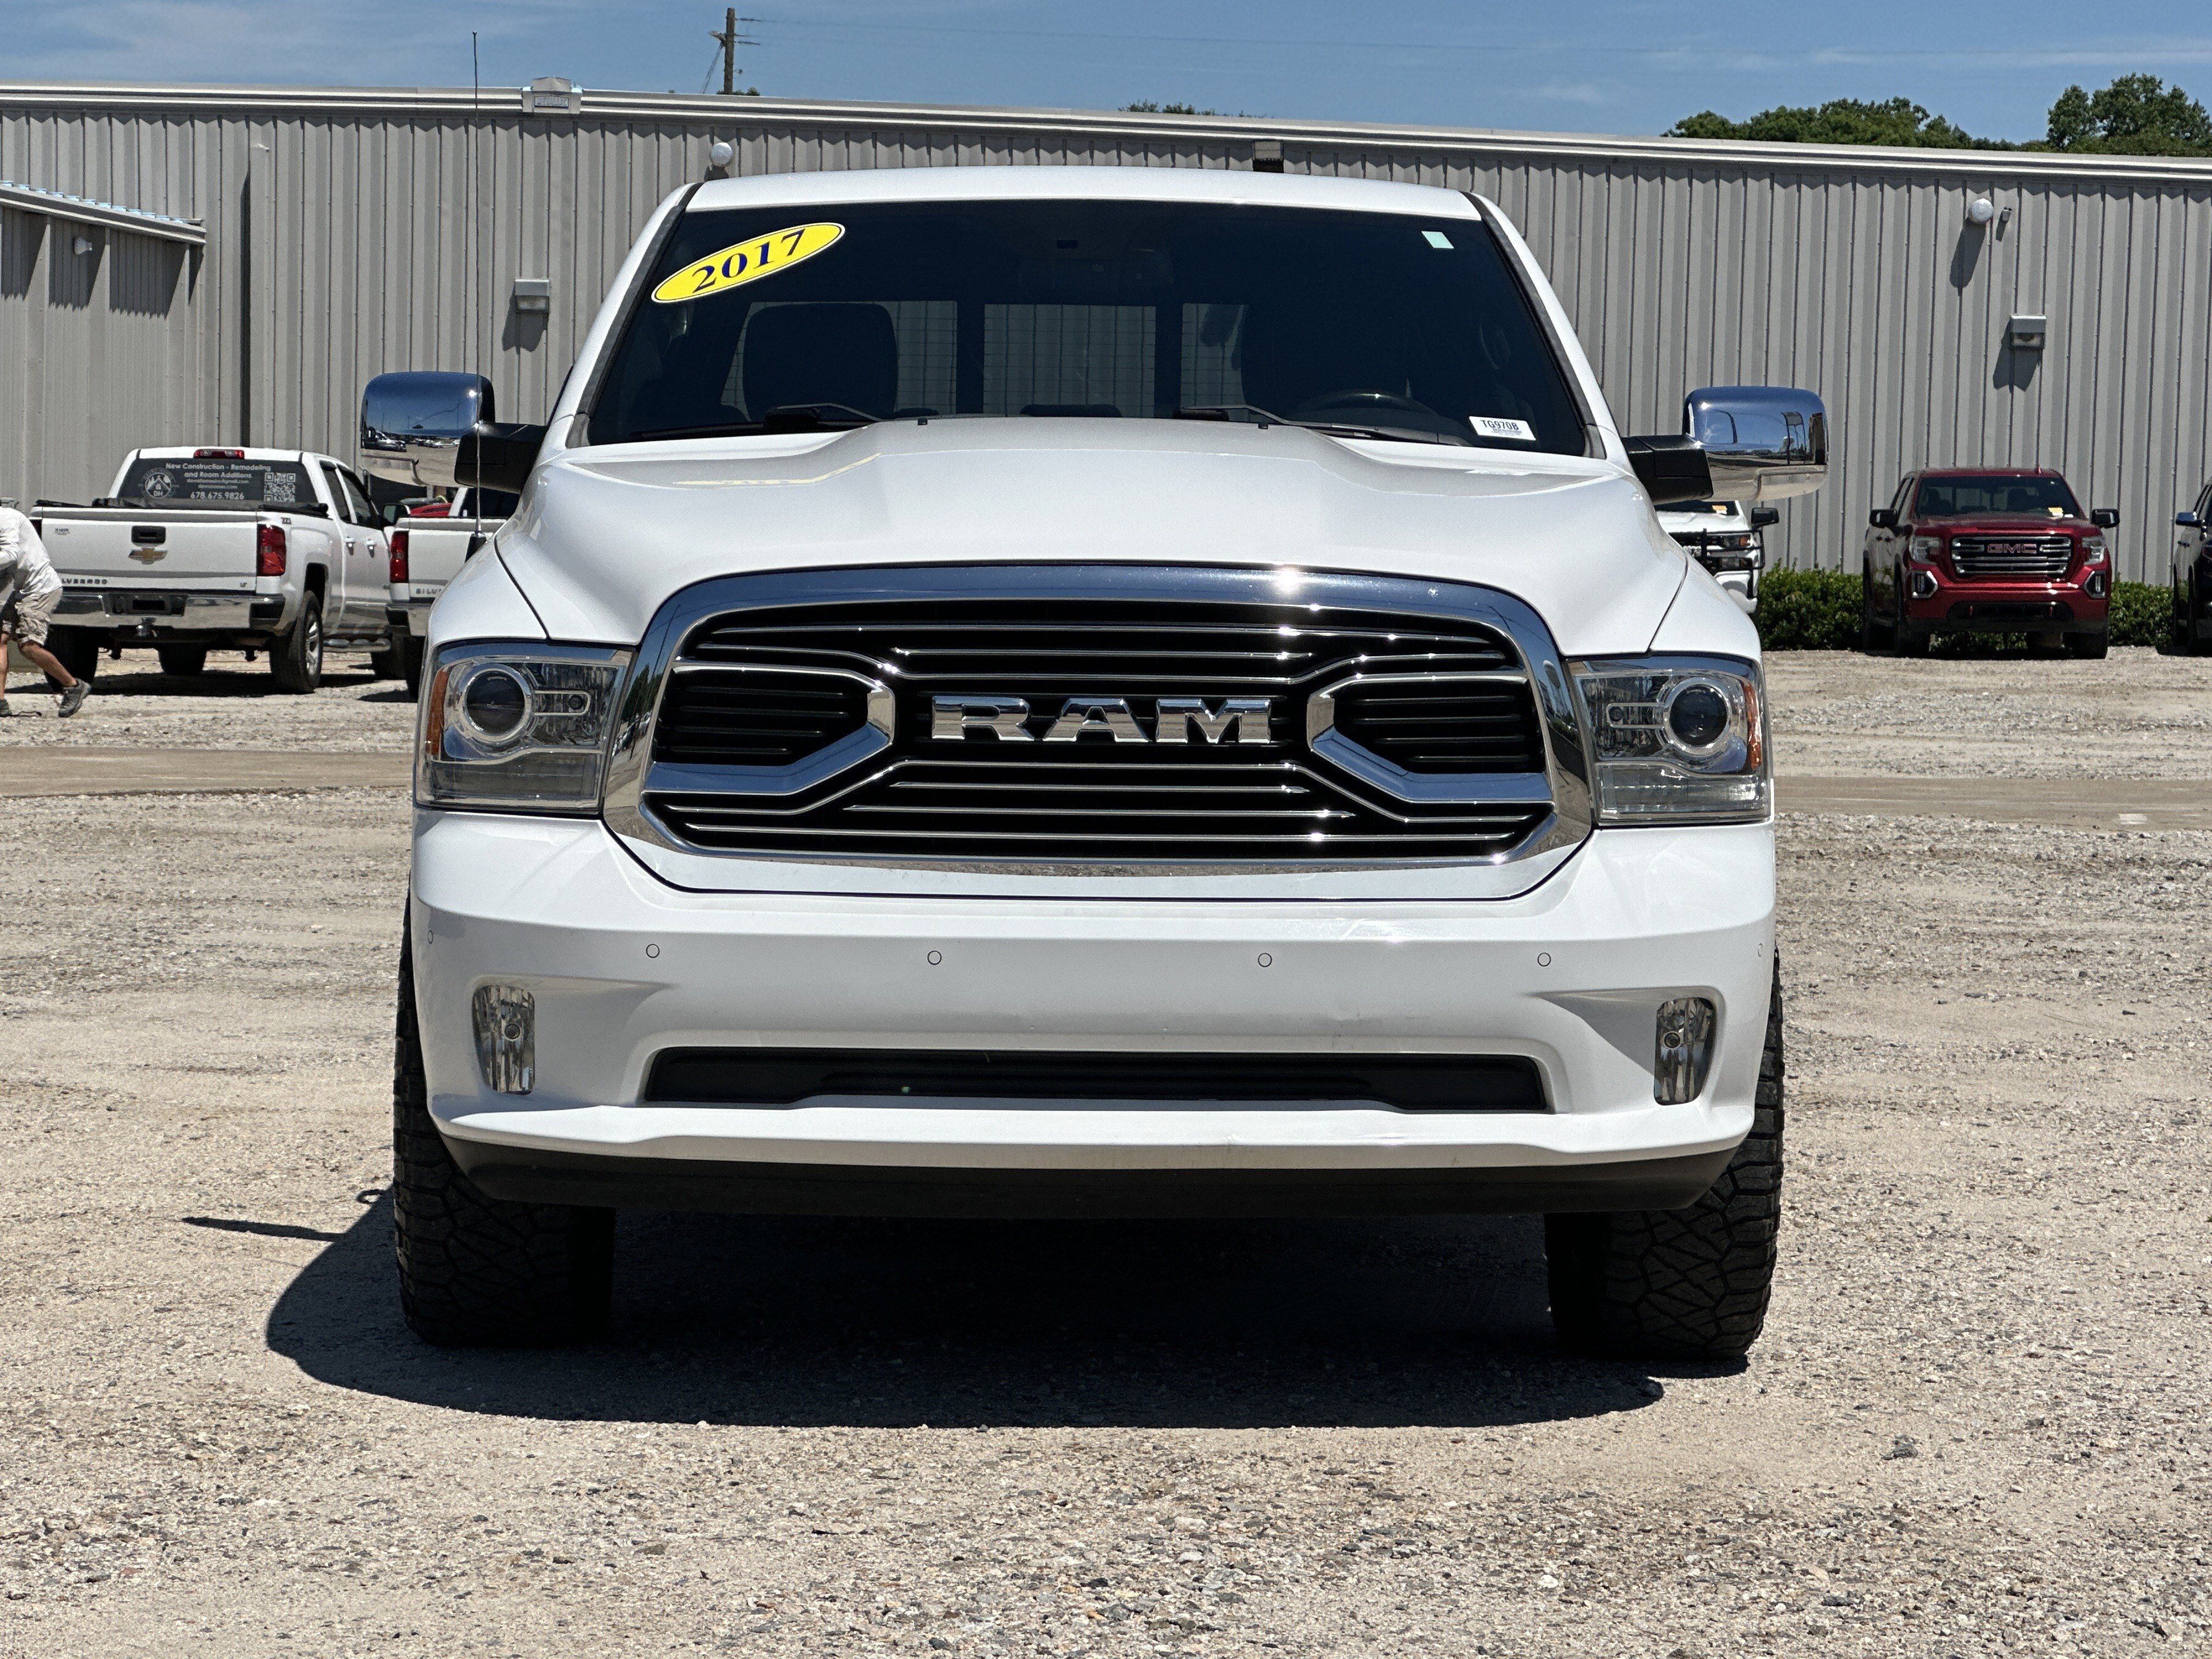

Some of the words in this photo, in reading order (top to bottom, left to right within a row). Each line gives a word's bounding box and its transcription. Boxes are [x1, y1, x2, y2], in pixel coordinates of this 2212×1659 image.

[692, 228, 805, 293] 2017
[1480, 420, 1519, 430] TG970B
[190, 492, 244, 500] 678.675.9826
[1987, 544, 2036, 554] GMC
[933, 695, 1271, 743] RAM
